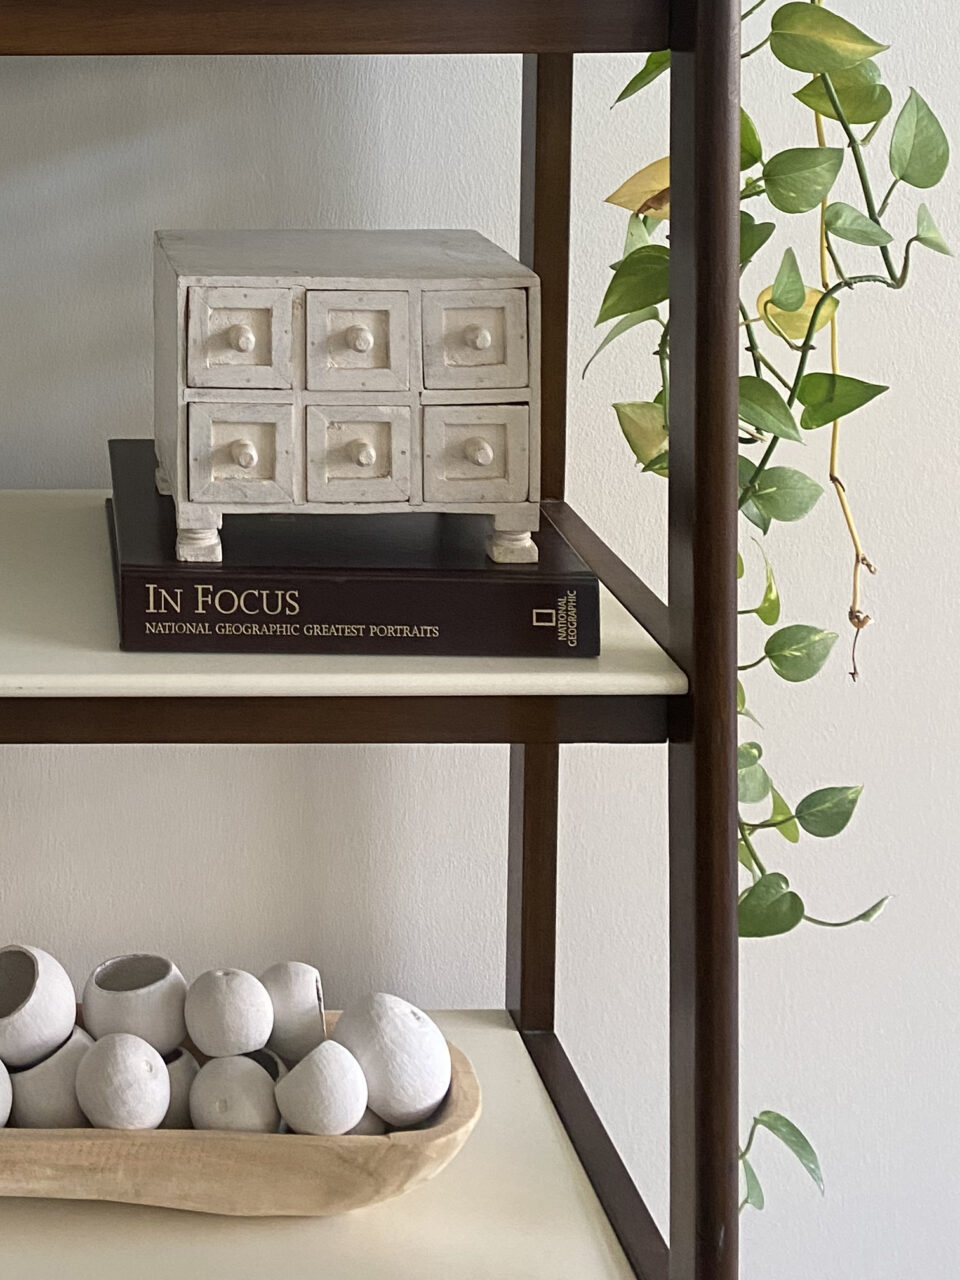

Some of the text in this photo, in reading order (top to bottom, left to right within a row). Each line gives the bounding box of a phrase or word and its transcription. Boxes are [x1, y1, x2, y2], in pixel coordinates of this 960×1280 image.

[145, 622, 439, 638] NATIONAL GEOGRAPHIC GREATEST PORTRAITS
[557, 596, 567, 641] NATIONAL
[567, 590, 577, 647] GEOGRAPHIC
